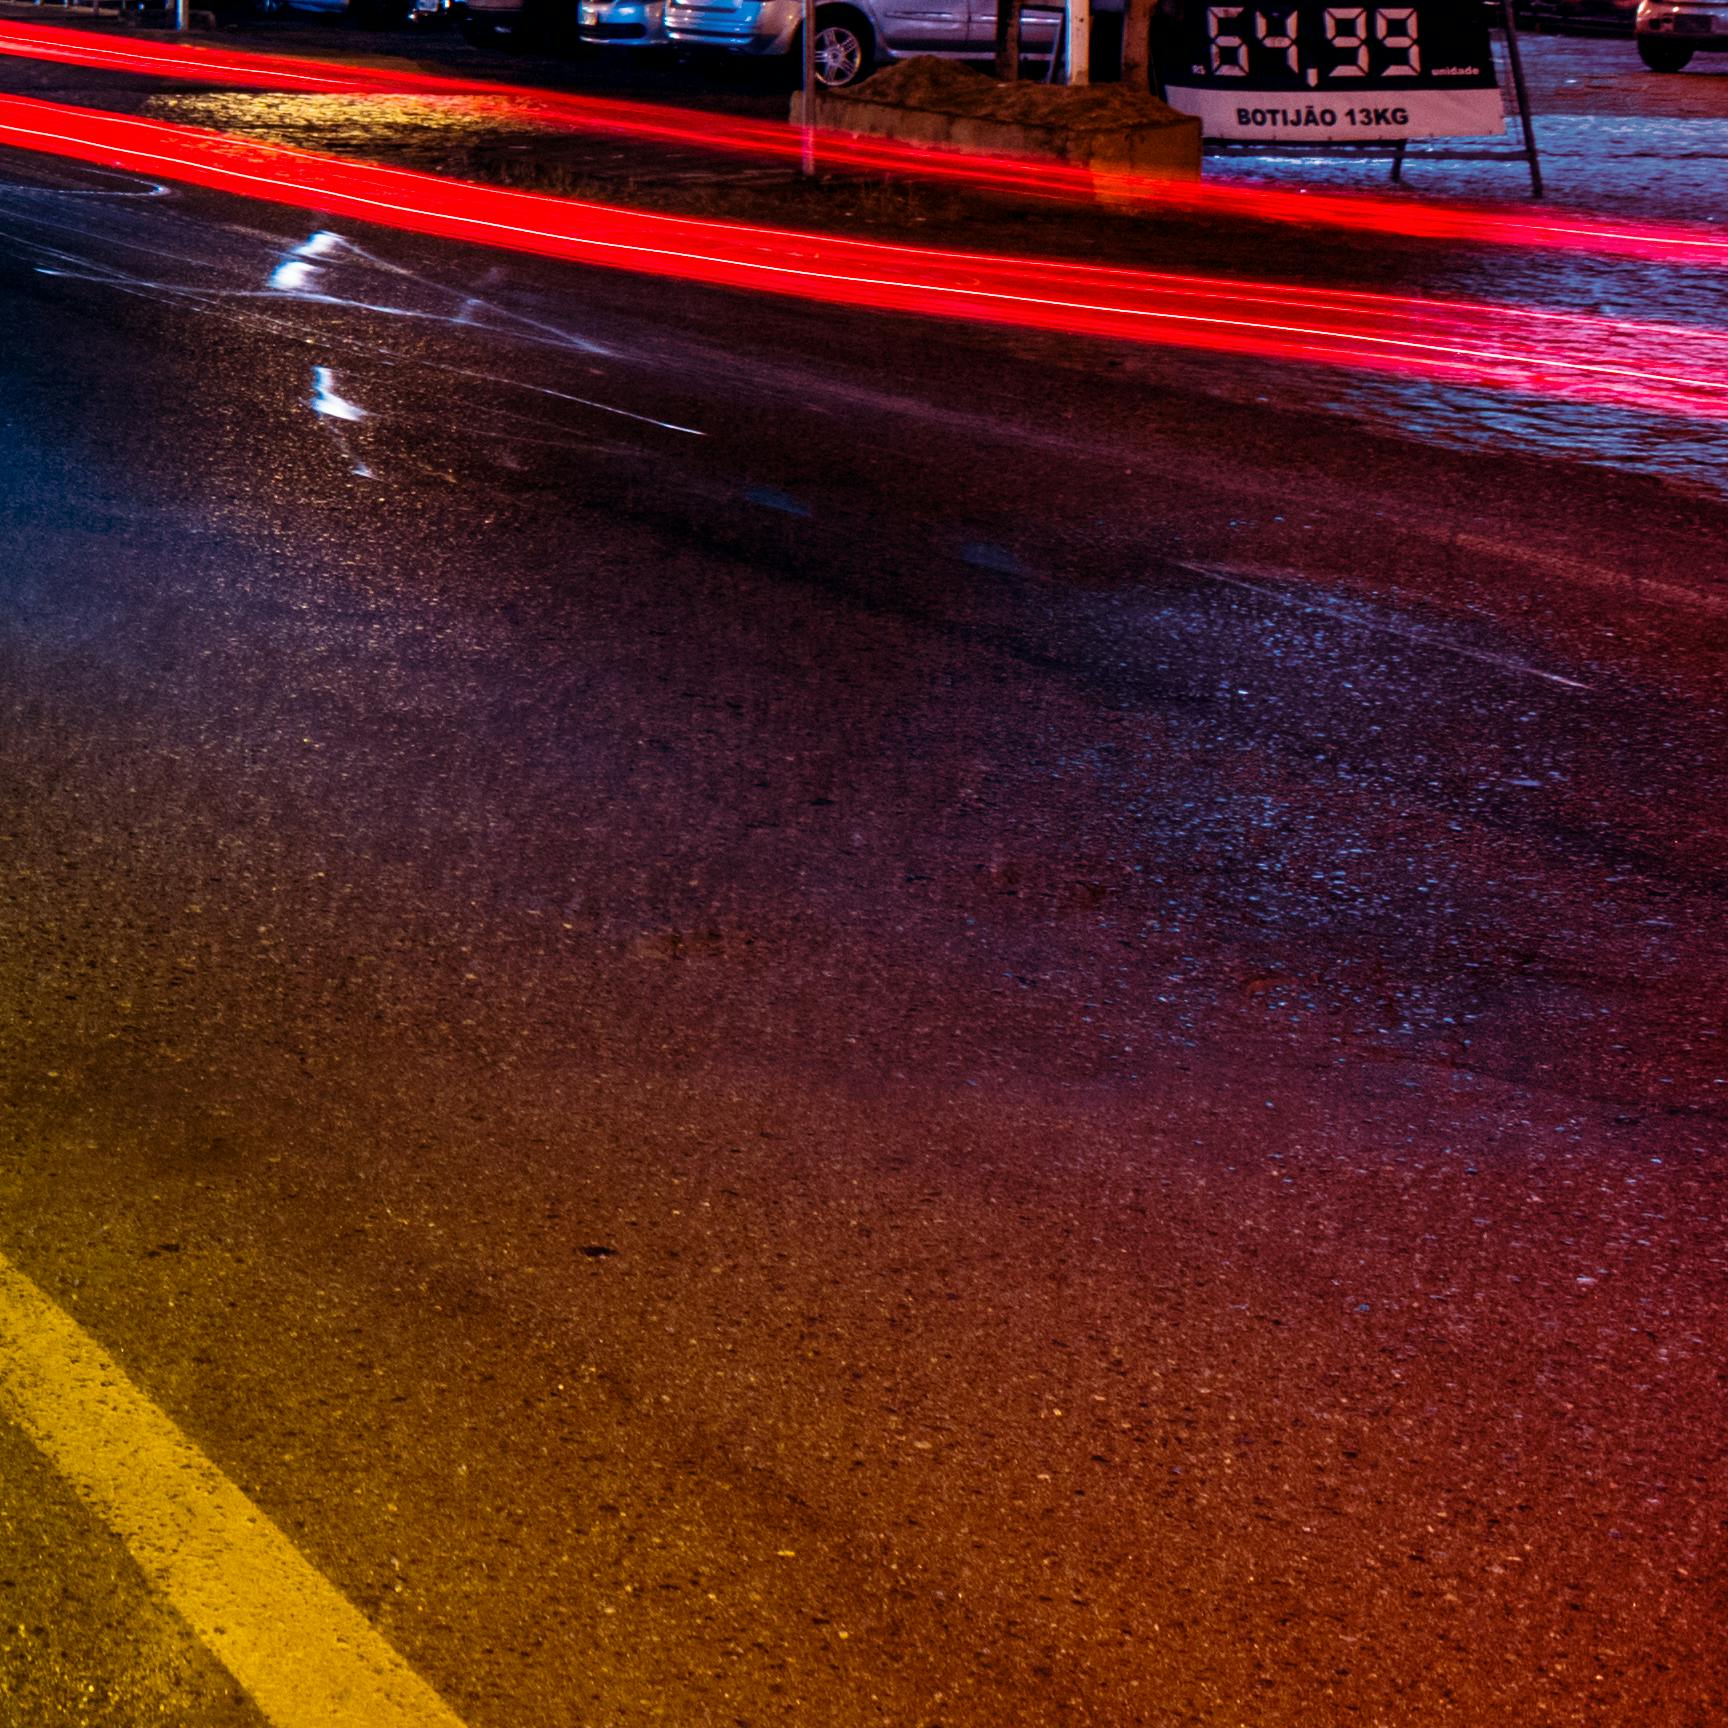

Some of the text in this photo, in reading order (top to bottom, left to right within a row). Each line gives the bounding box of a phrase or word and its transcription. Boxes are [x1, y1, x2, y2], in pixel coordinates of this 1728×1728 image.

[1208, 6, 1421, 88] 64,99
[1432, 65, 1480, 76] unidade
[1236, 105, 1409, 127] BOTIJÃO 13KG
